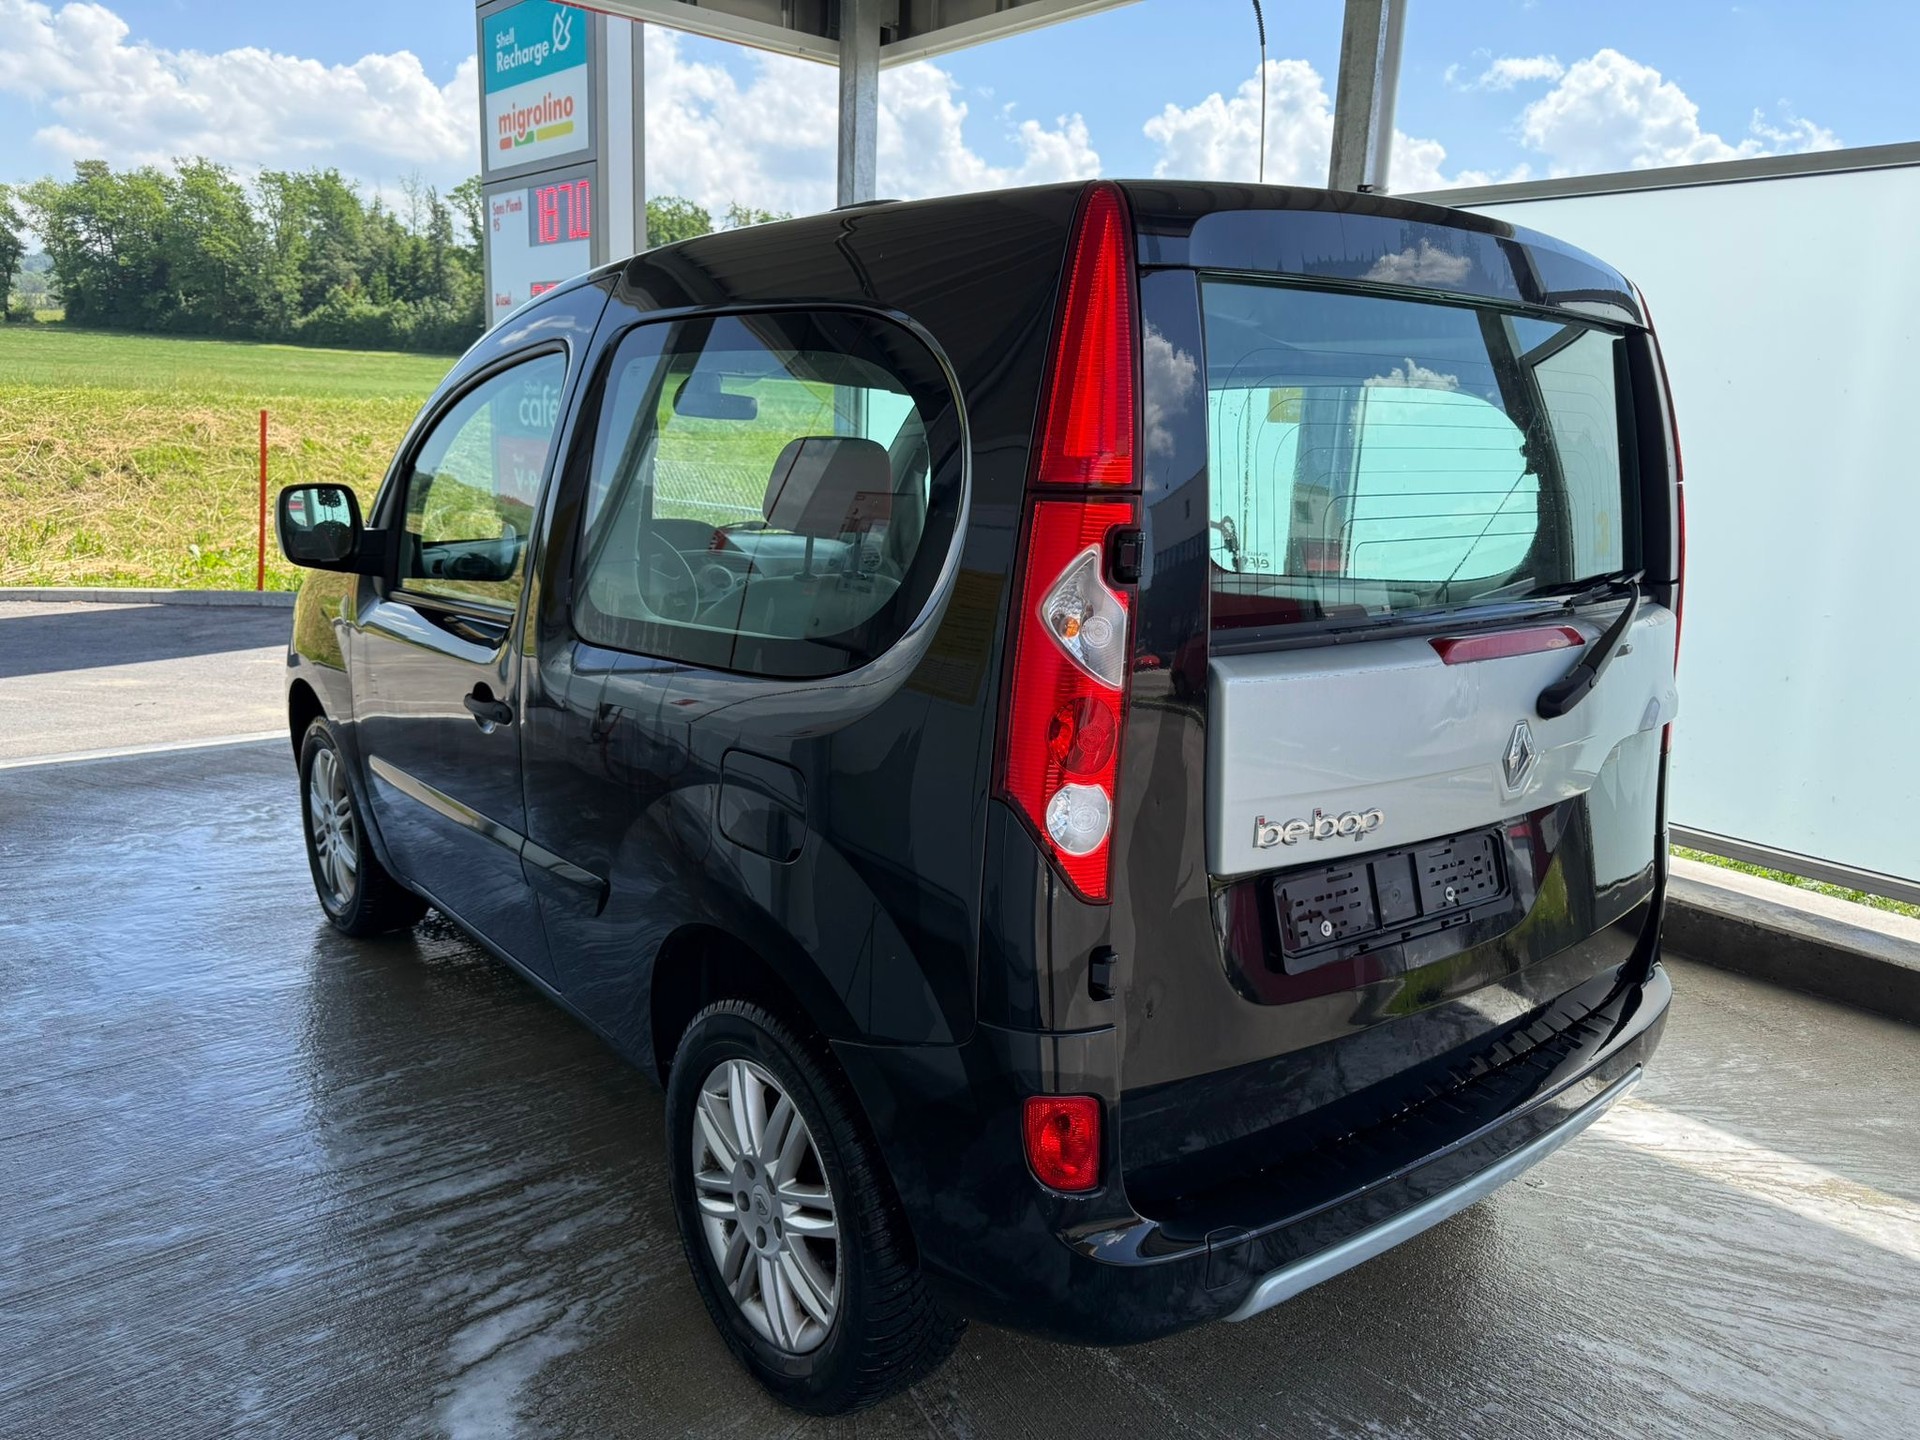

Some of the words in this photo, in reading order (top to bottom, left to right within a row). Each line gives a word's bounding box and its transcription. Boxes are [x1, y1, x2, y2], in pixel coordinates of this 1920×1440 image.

[496, 27, 515, 48] Shell
[496, 41, 549, 72] Recharge
[499, 92, 574, 139] migrolino
[492, 200, 505, 216] Sans
[505, 196, 522, 213] Plomb
